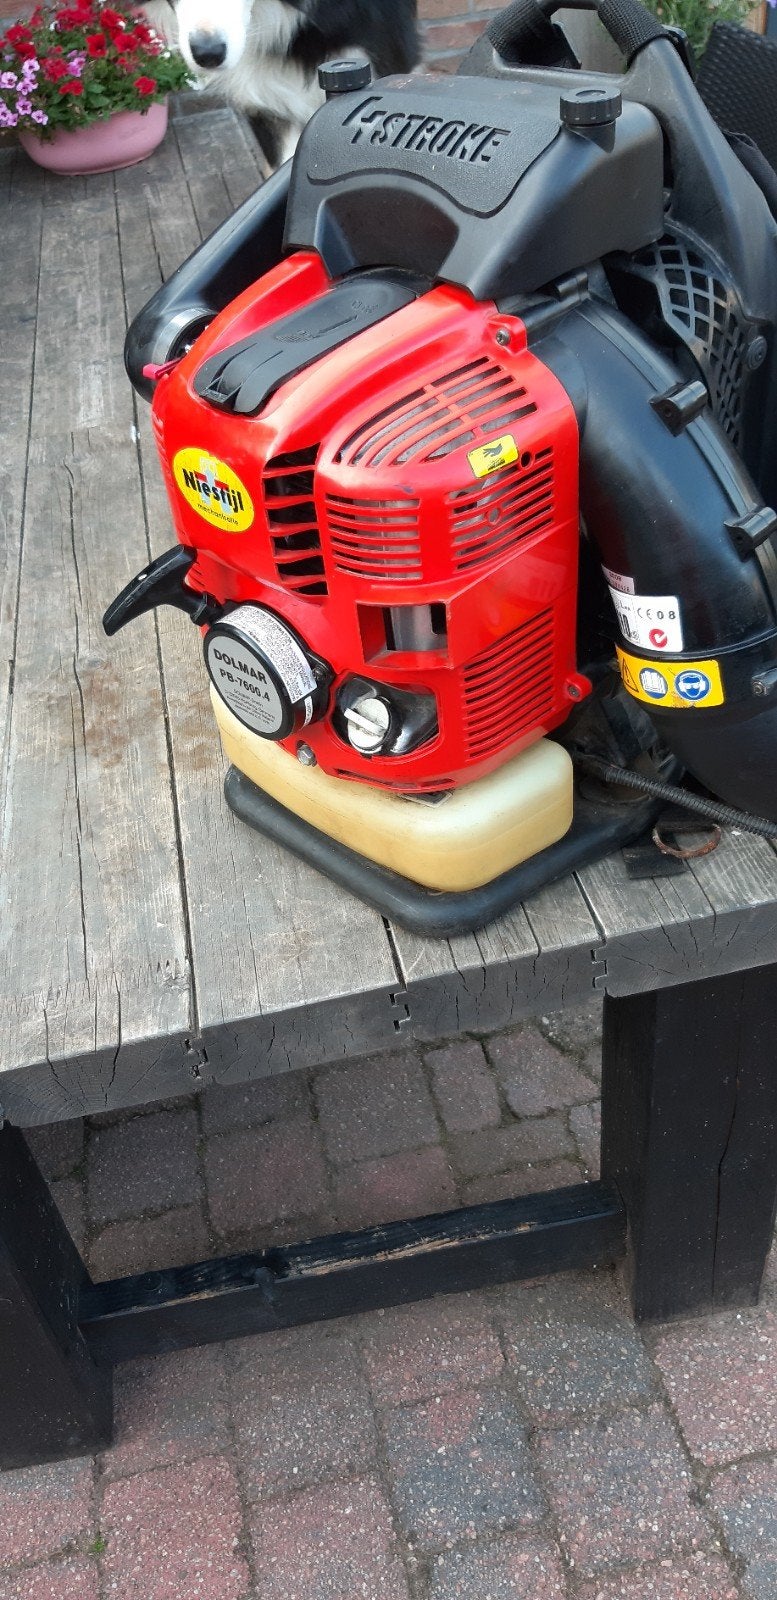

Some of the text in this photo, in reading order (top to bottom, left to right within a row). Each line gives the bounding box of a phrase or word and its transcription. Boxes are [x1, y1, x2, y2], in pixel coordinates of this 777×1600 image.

[182, 468, 244, 513] Niestijl
[213, 648, 268, 685] DOLMAR
[219, 667, 270, 702] PB-7600.4
